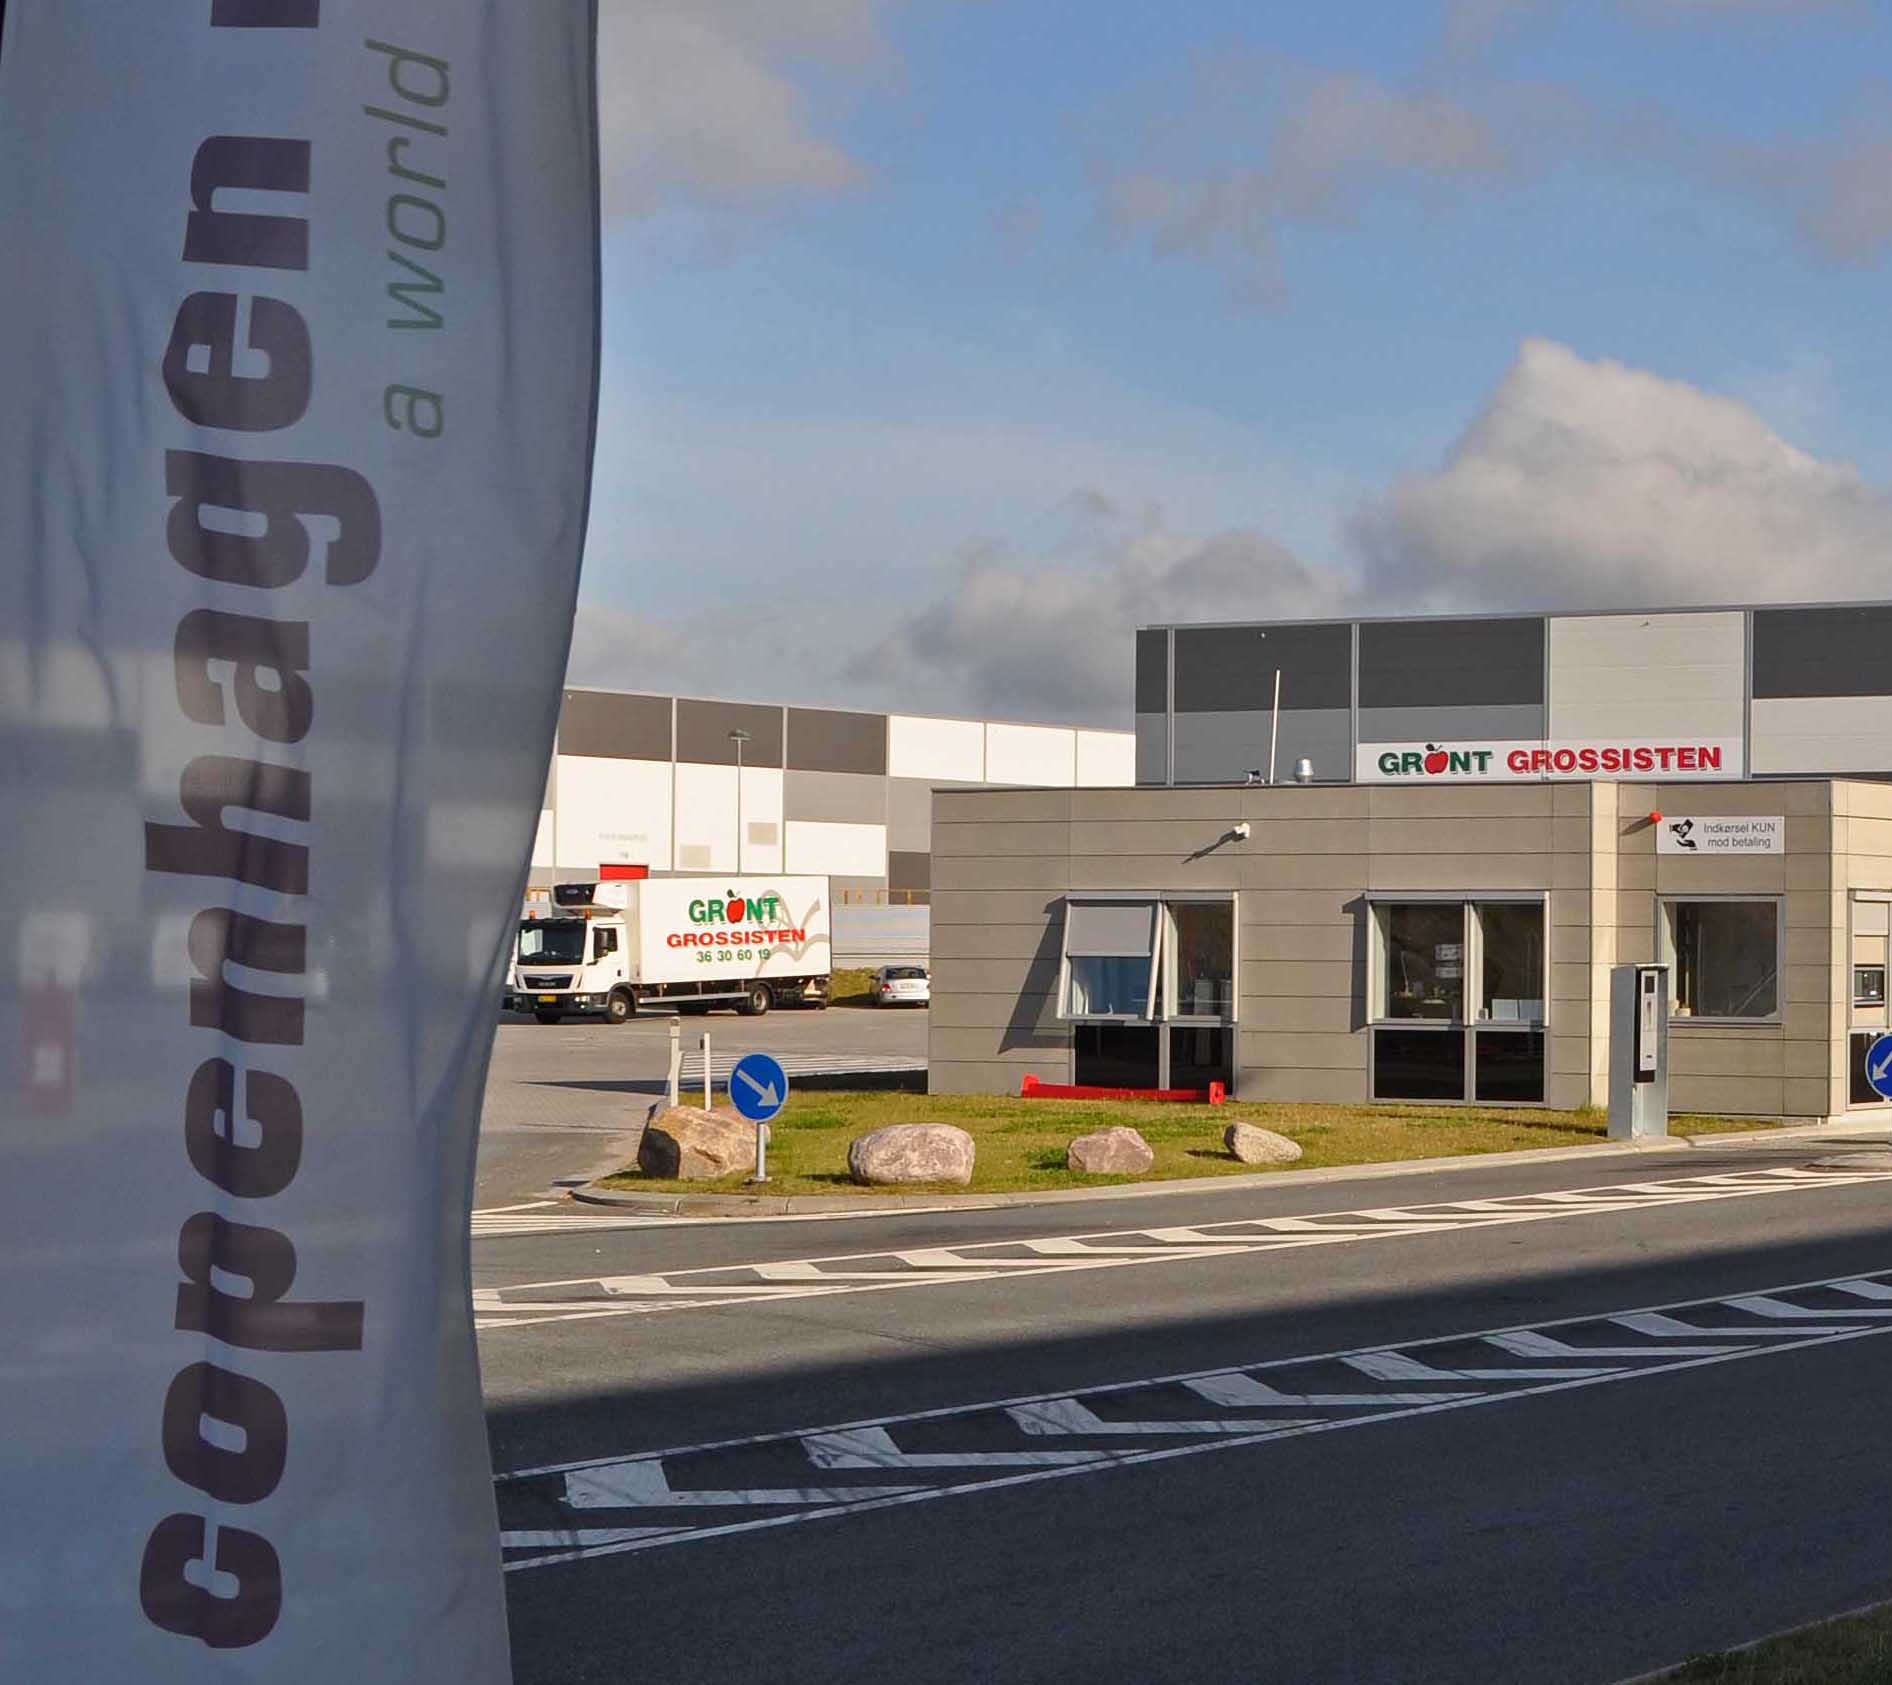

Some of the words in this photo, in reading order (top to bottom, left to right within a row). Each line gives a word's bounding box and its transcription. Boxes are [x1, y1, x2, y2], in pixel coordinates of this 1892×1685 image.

[362, 38, 450, 331] world
[384, 383, 444, 439] a
[1507, 747, 1722, 773] GROSSISTEN
[1703, 822, 1749, 833] Indkørsel
[1751, 822, 1776, 833] KUN
[1707, 837, 1730, 848] mod
[1732, 837, 1771, 849] betaling
[140, 134, 383, 1649] copenhagen
[667, 928, 806, 948] GROSSISTEN
[696, 951, 712, 963] 36
[717, 950, 733, 962] 30
[737, 949, 753, 961] 60
